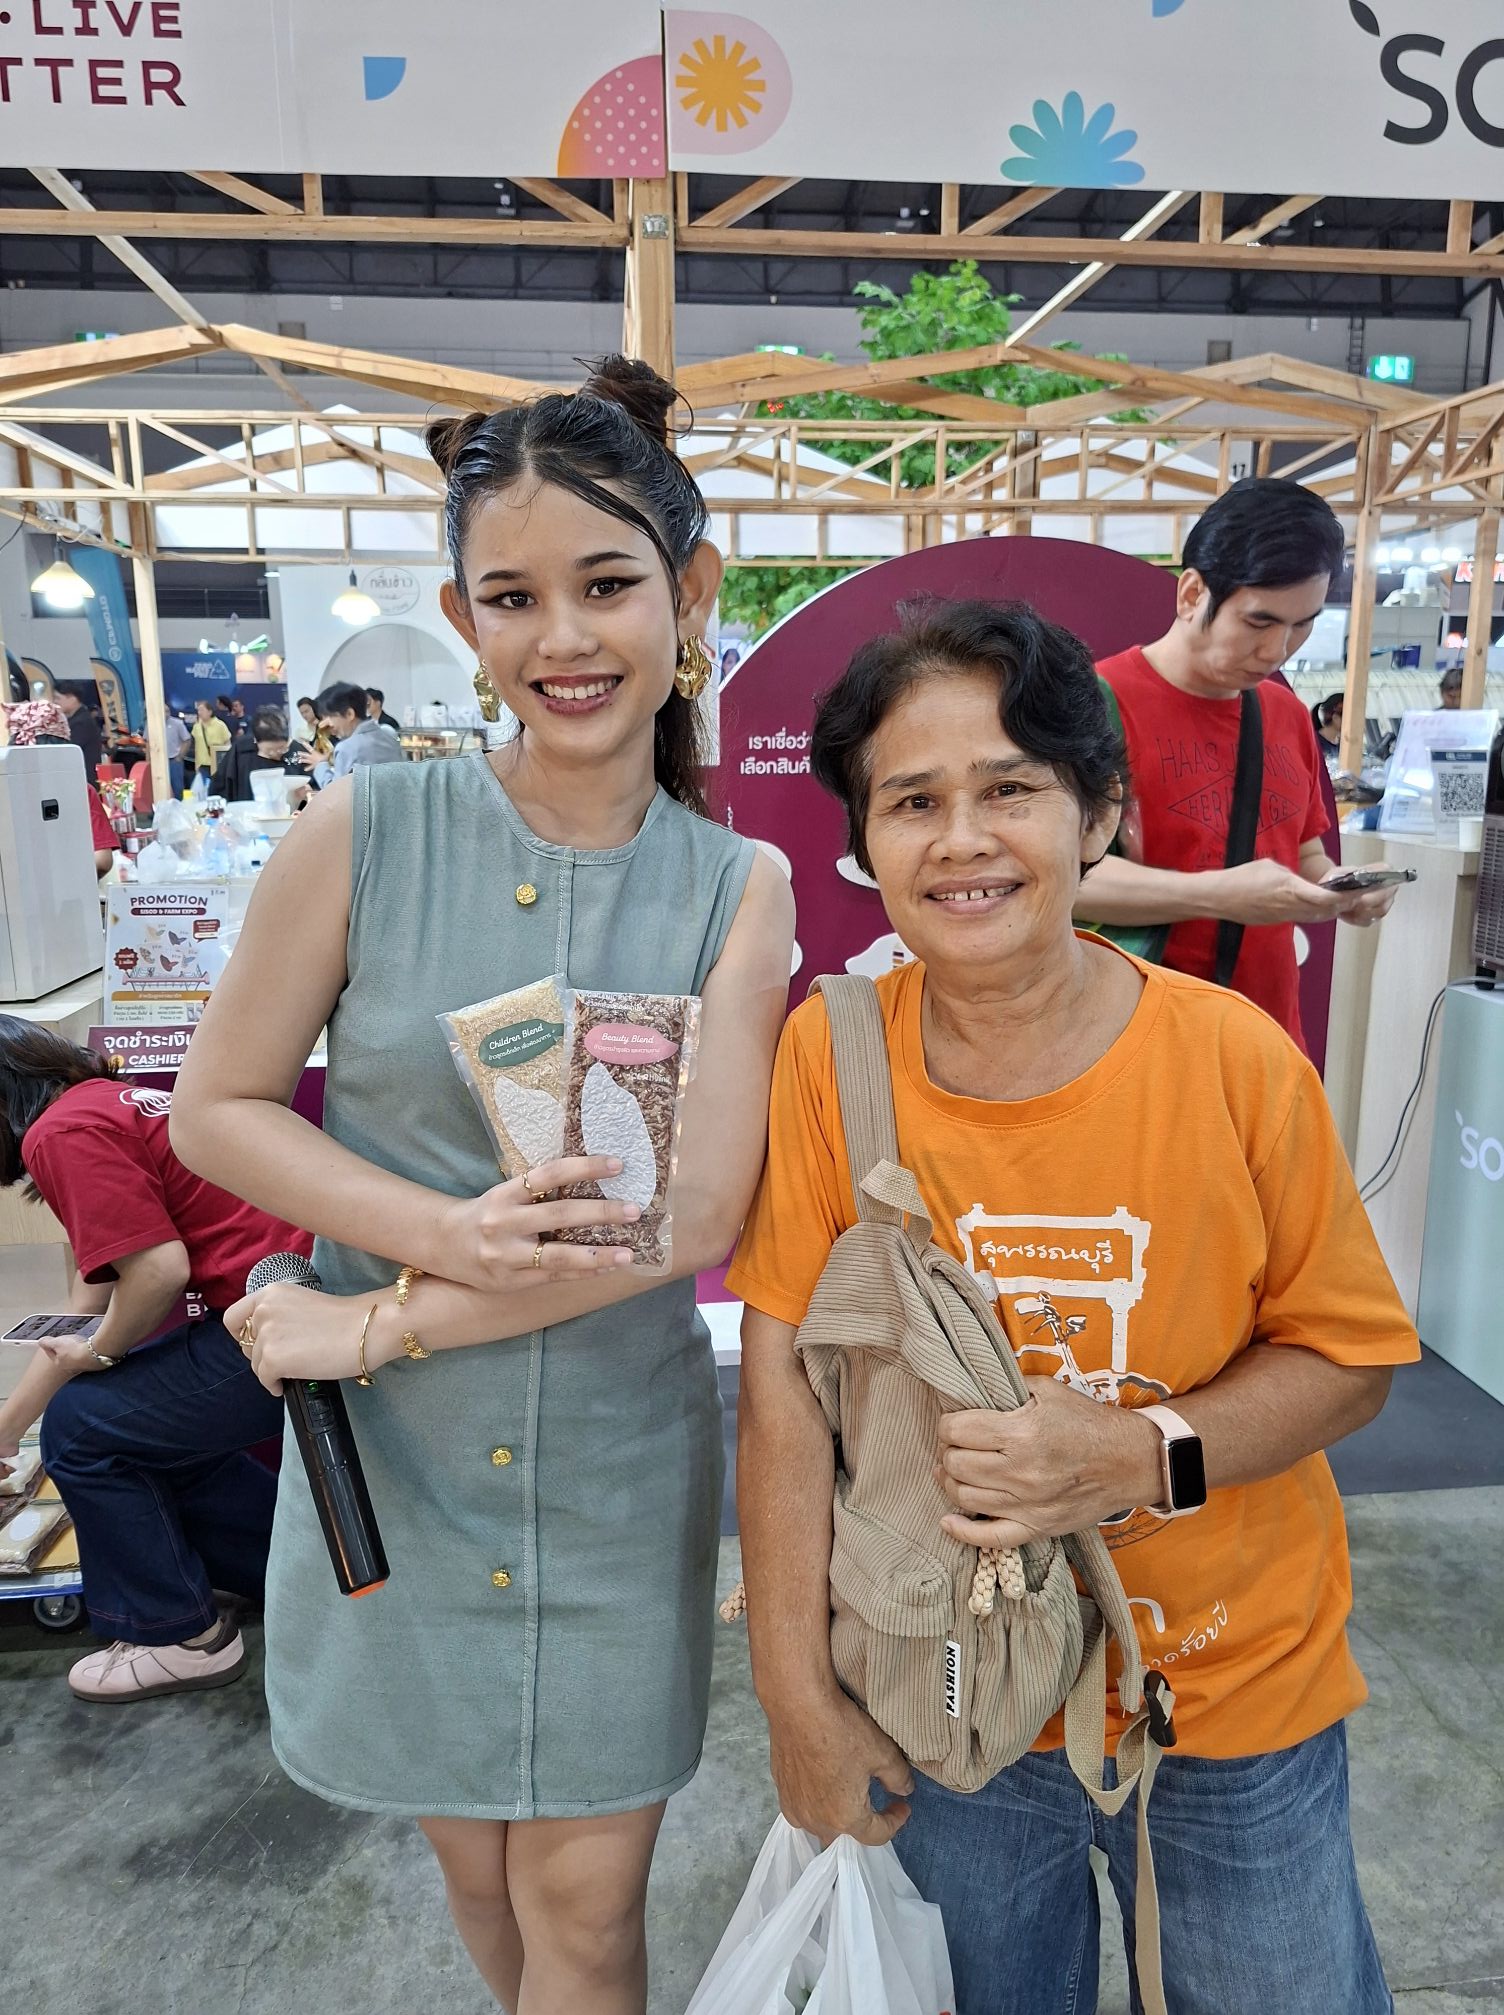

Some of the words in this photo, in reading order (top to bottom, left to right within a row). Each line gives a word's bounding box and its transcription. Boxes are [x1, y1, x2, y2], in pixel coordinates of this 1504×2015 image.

[32, 0, 182, 38] LIVE
[1156, 737, 1221, 783] HAAS
[1229, 743, 1299, 786] JNS
[130, 894, 208, 907] PROMOTION
[489, 1029, 522, 1051] Children
[522, 1022, 544, 1041] Blend
[601, 1031, 629, 1045] Beauty
[631, 1032, 655, 1044] Blend
[946, 1645, 956, 1714] FASHION
